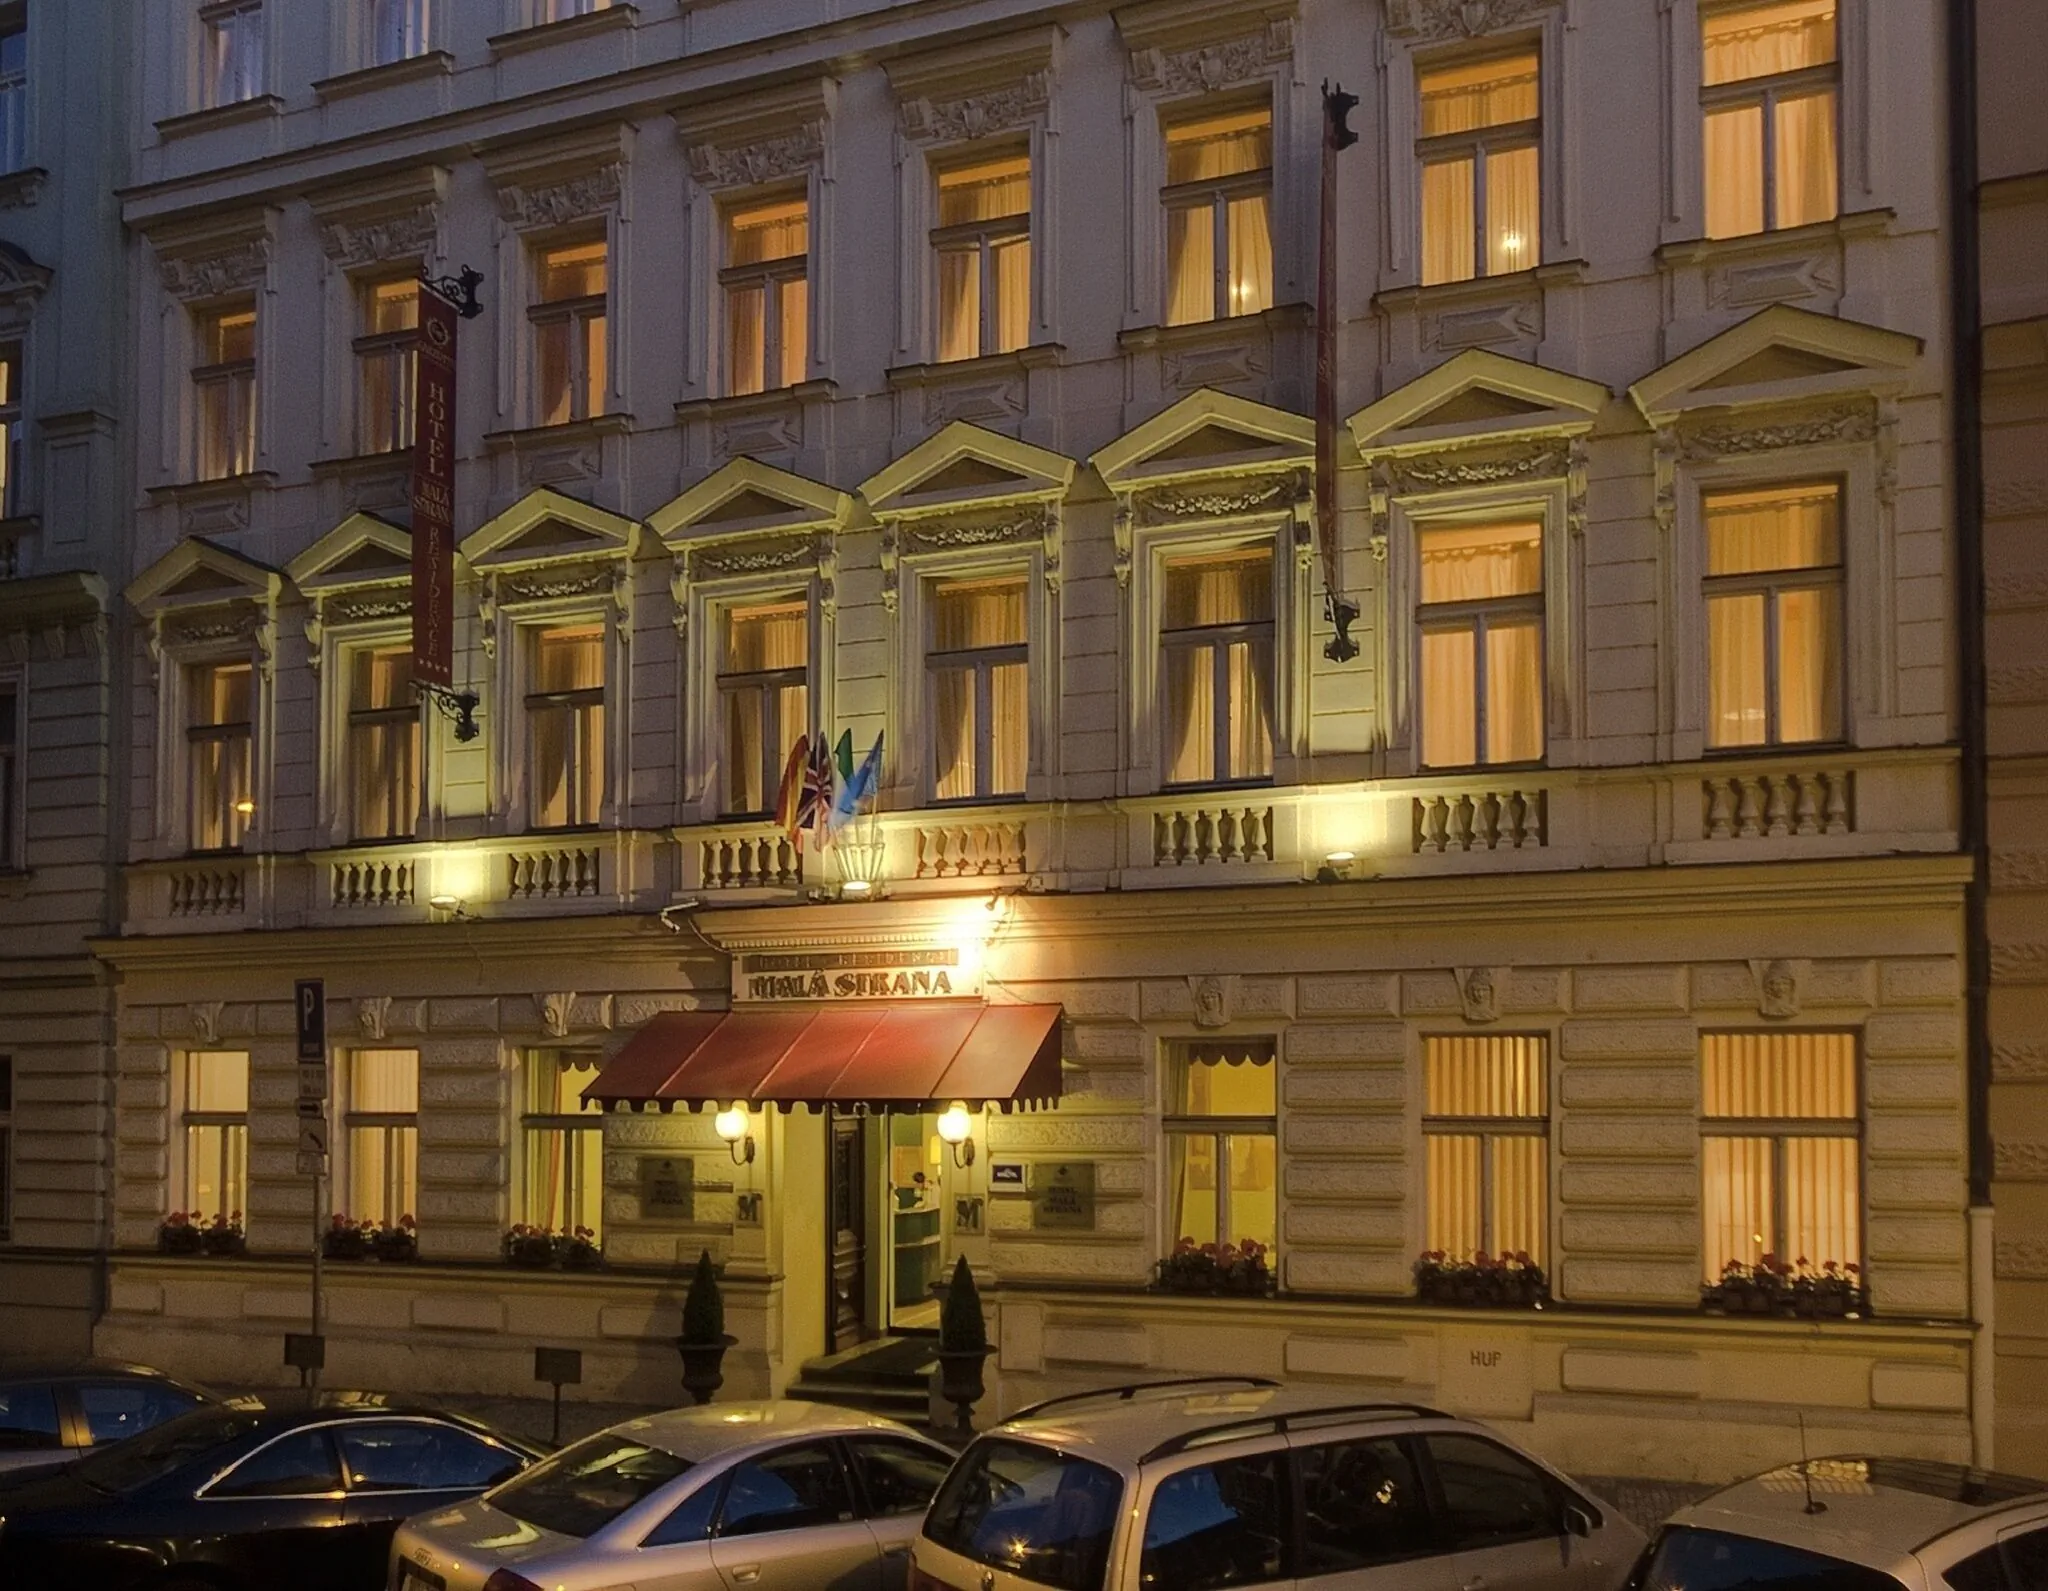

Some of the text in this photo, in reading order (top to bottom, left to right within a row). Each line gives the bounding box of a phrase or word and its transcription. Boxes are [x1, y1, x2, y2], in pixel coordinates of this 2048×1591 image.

[428, 382, 445, 477] HOTEL
[426, 527, 441, 658] RESIDENCE
[747, 968, 953, 999] MALÁ STRANA
[303, 987, 315, 1031] P
[1470, 1350, 1501, 1367] HUP
